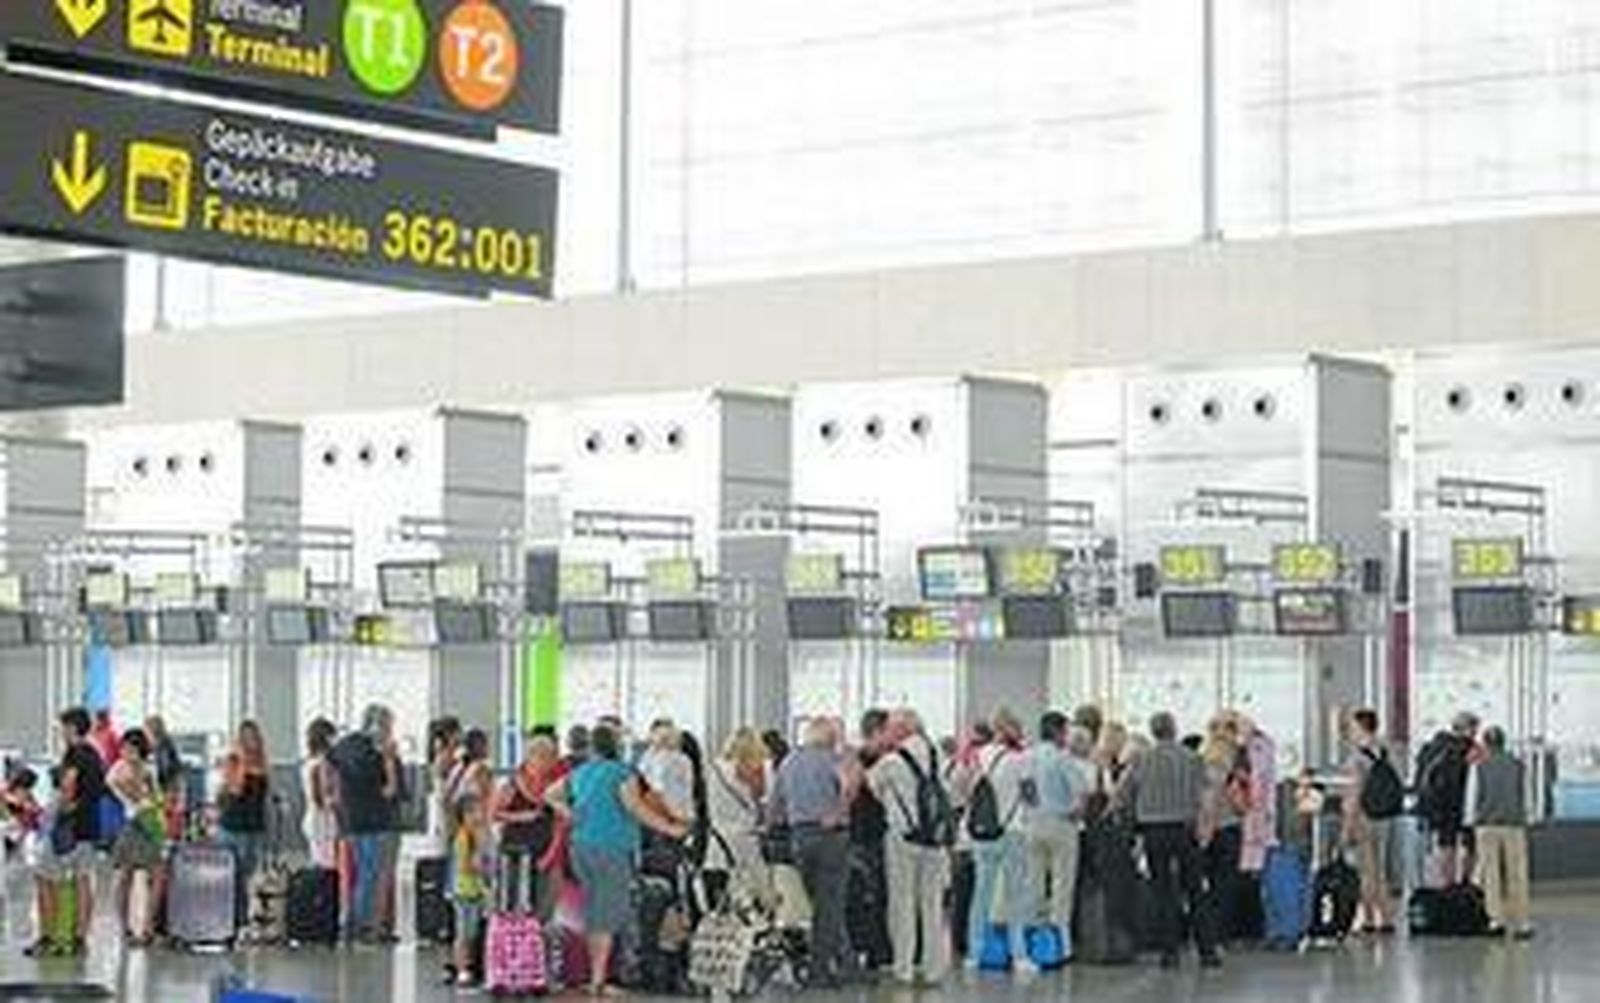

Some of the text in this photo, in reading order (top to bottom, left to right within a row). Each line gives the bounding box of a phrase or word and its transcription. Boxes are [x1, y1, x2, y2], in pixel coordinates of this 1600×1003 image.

[205, 22, 329, 77] Terminal
[350, 5, 408, 66] T1
[450, 24, 505, 82] T2
[383, 210, 542, 279] 362:001
